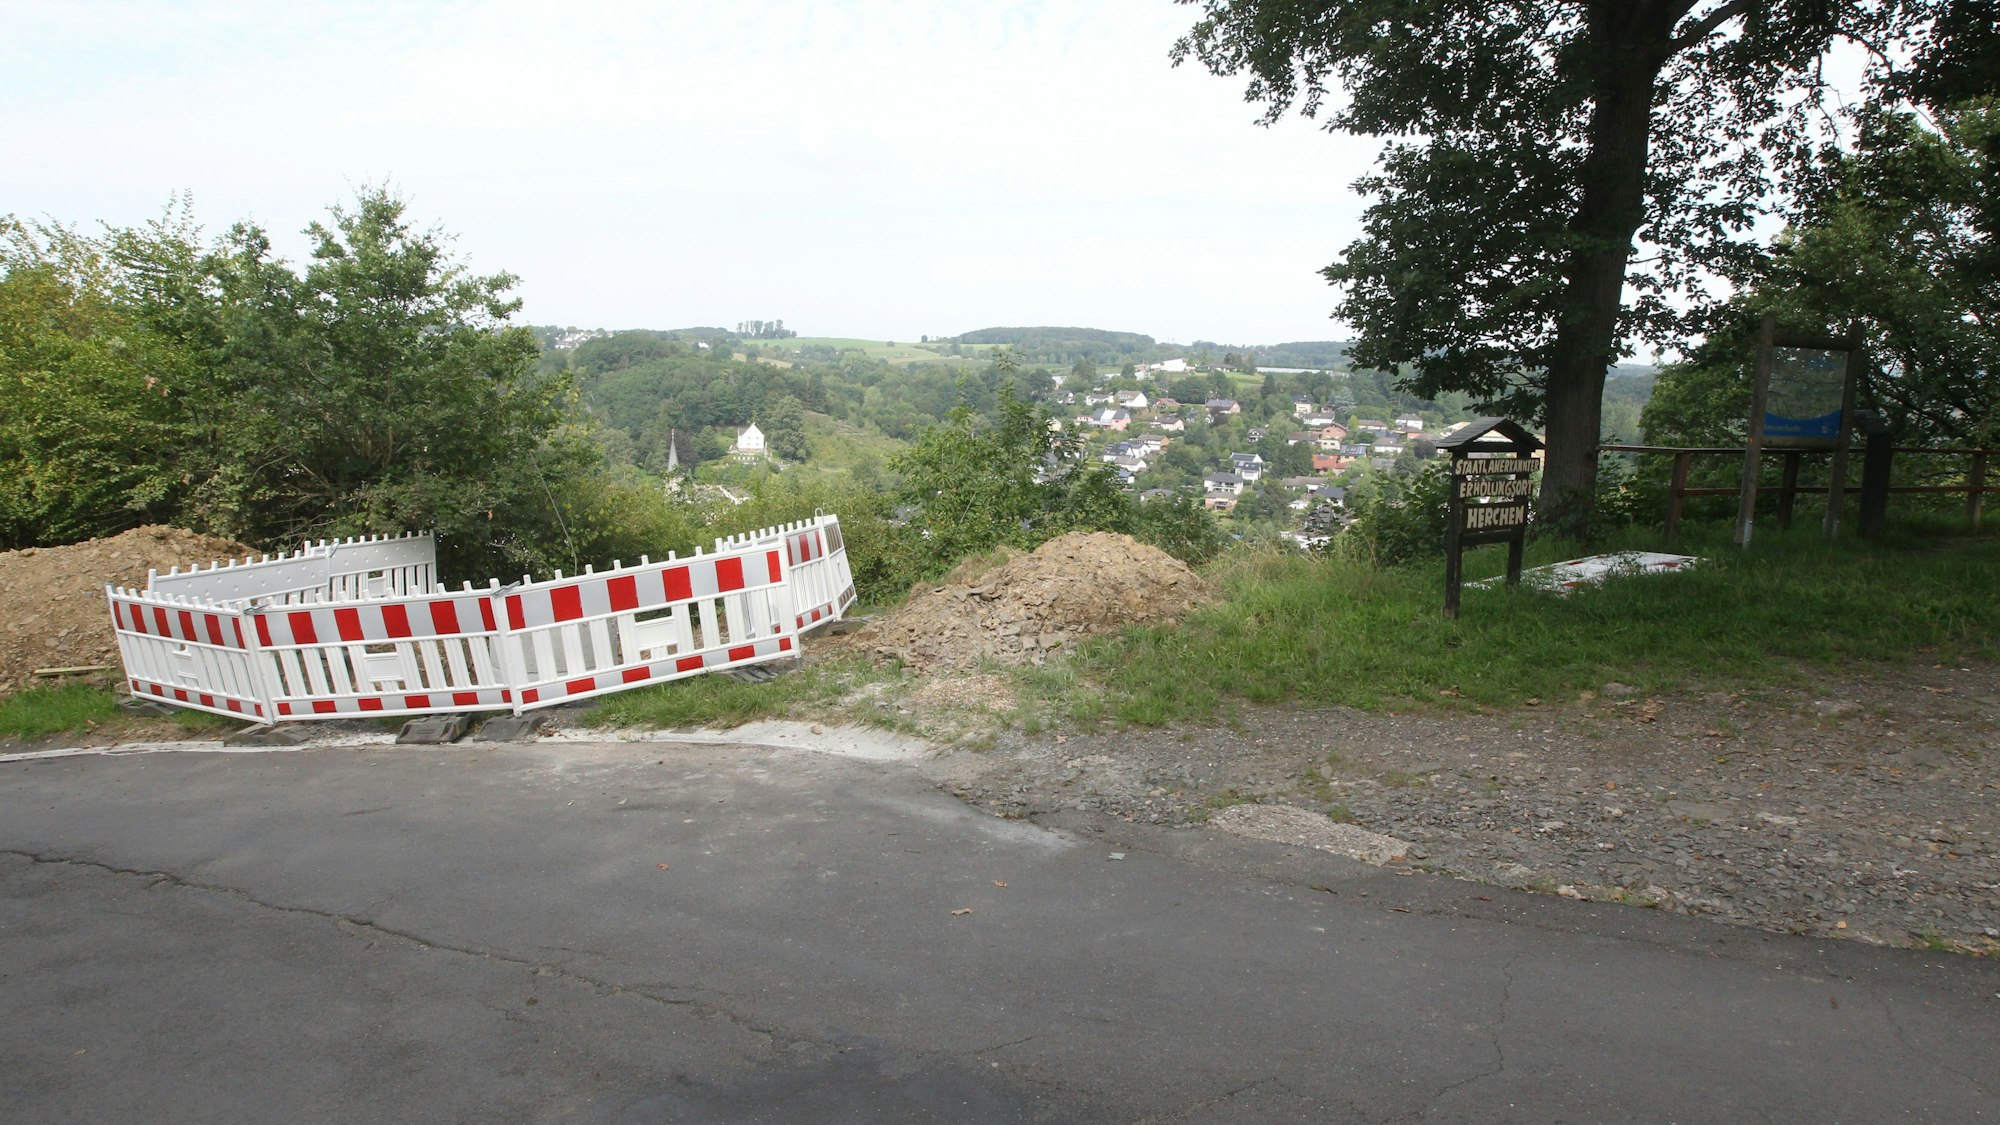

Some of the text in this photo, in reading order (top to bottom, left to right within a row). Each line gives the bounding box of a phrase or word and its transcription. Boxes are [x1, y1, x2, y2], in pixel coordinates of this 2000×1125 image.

[1488, 459, 1539, 473] ANERKANNTER
[1460, 479, 1533, 498] ERHOLUNGSORT
[1467, 505, 1524, 528] HERCHEN
